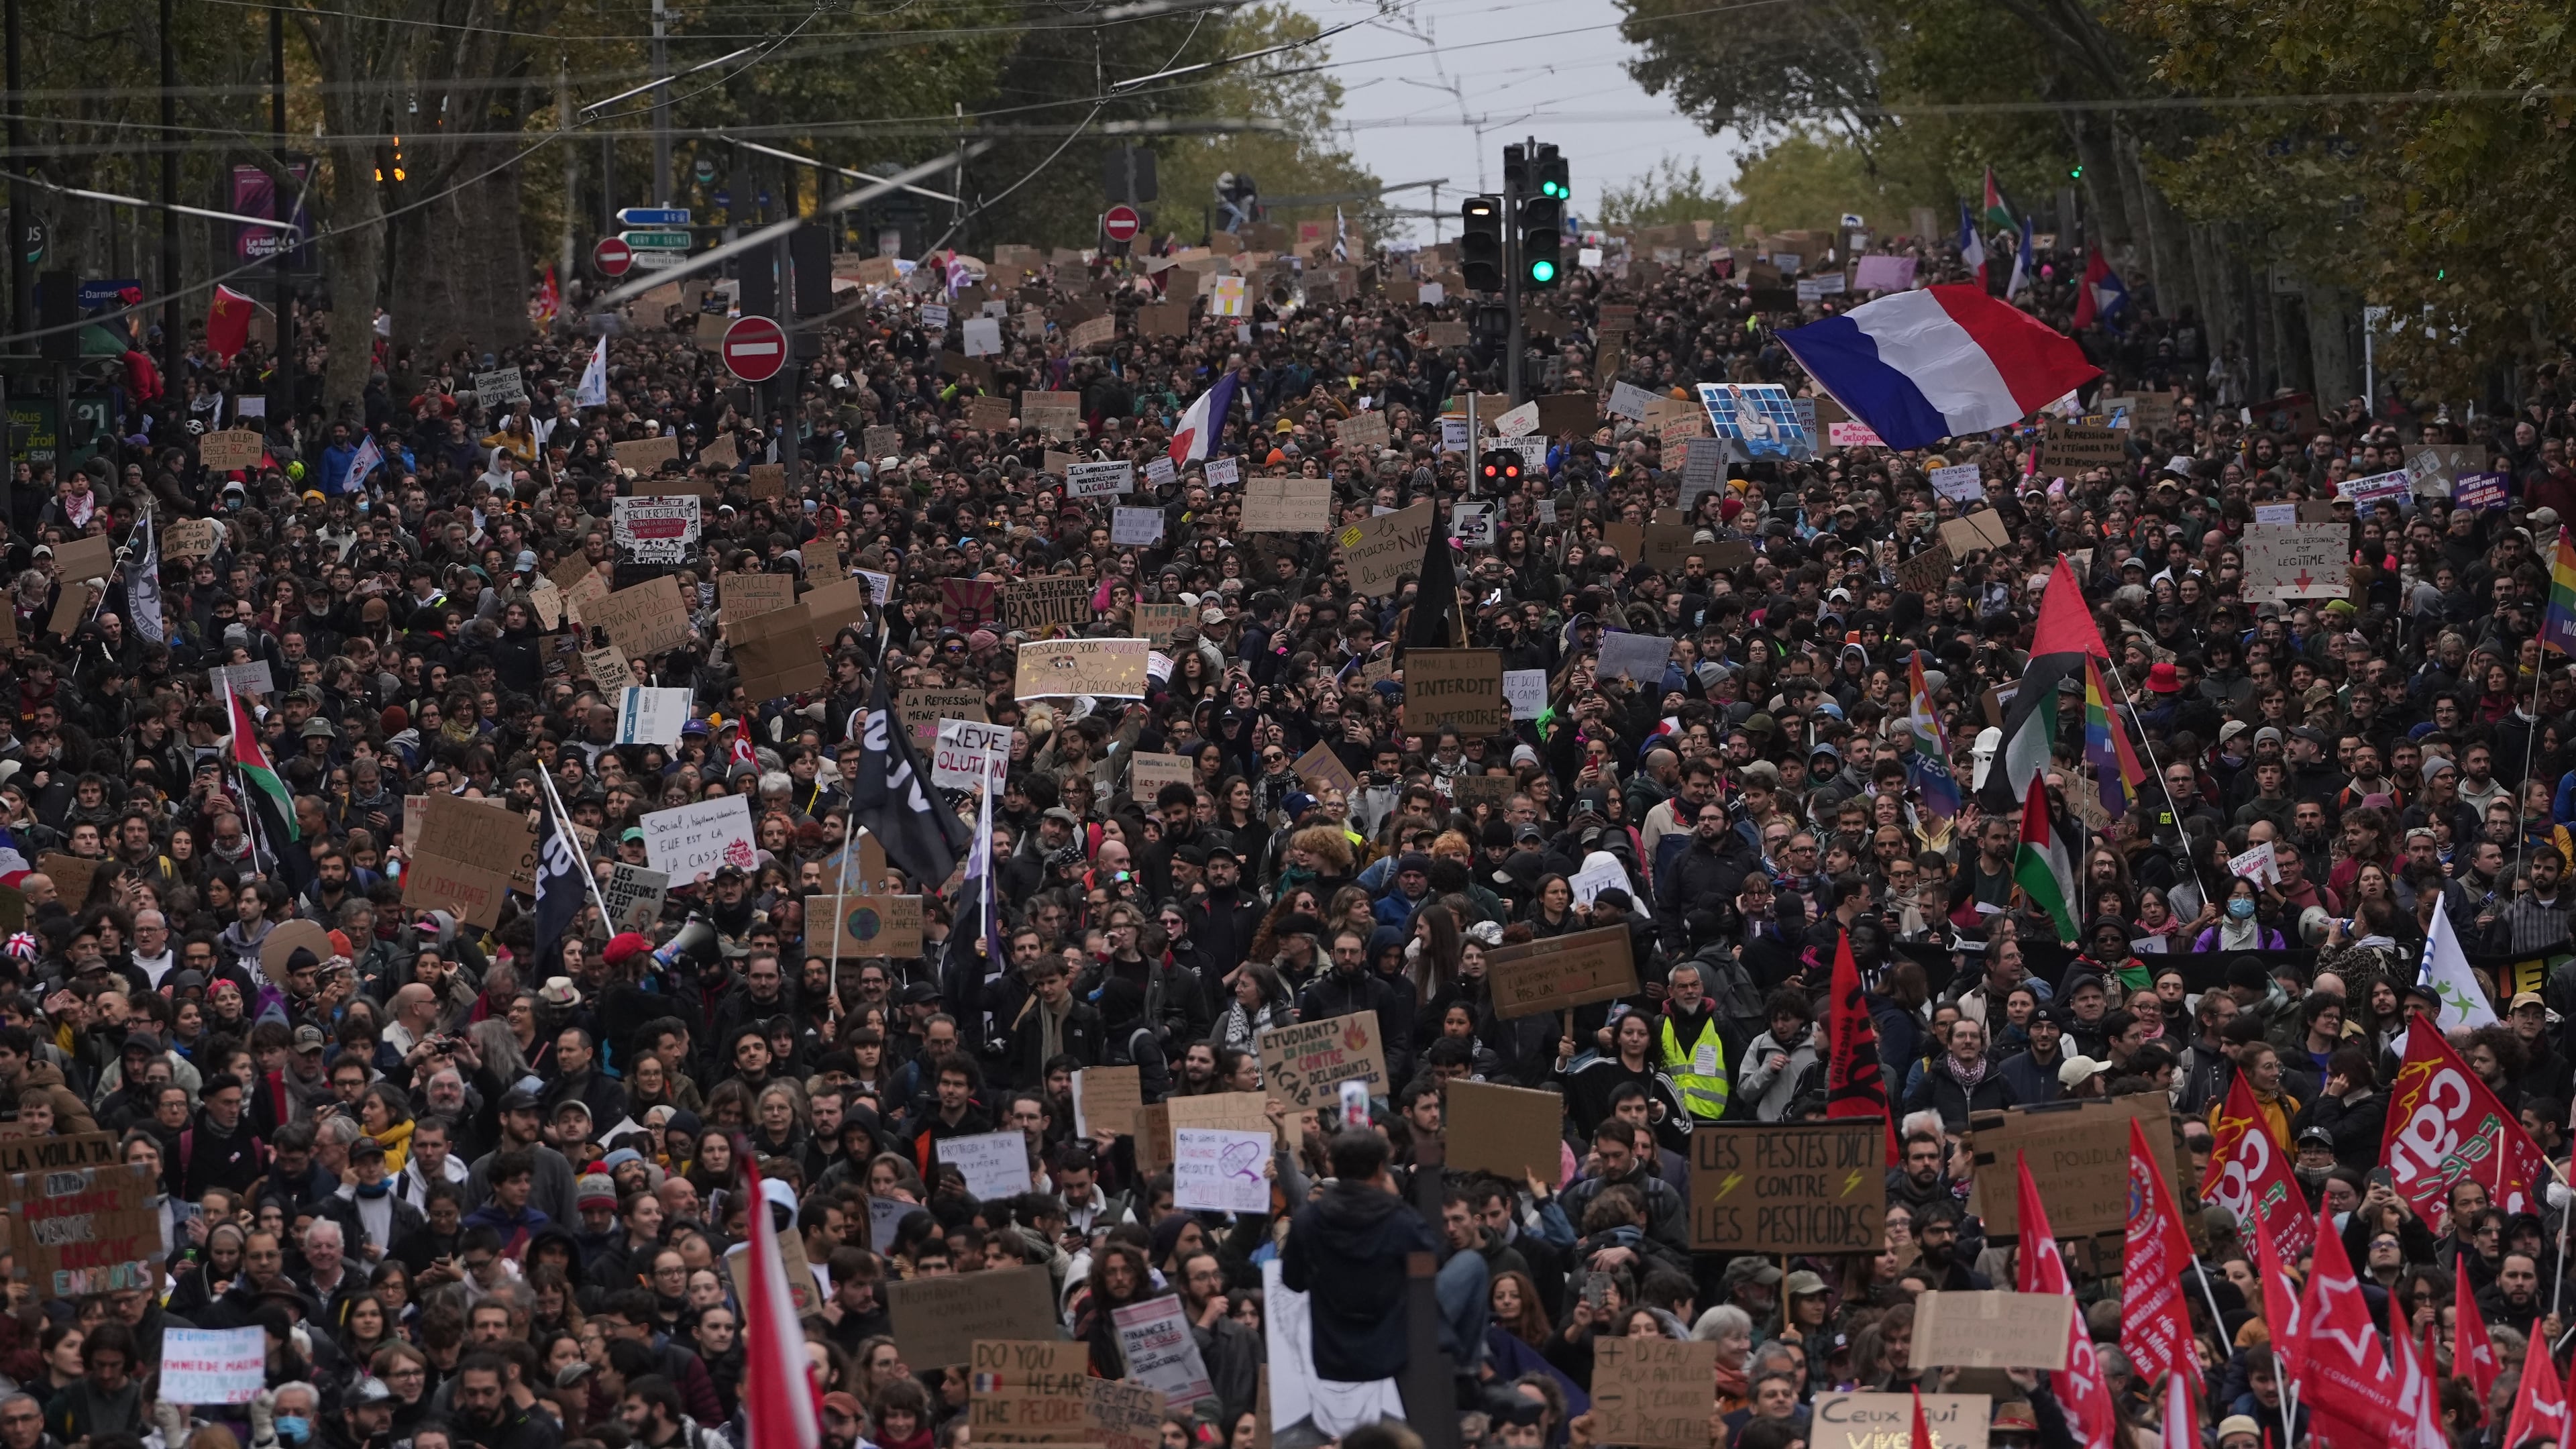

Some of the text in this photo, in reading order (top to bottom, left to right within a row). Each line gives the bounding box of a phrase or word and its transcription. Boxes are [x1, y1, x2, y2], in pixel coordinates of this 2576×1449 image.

[2048, 427, 2059, 441] LA
[2104, 443, 2121, 453] PAS
[2044, 457, 2061, 466] NOS
[1299, 482, 1327, 492] VAUT
[2459, 475, 2482, 486] BAISSE
[2469, 478, 2496, 490] DES PRIX
[1079, 482, 1120, 494] LA COLÈRE
[2459, 486, 2498, 501] HAUSSE DES
[2471, 492, 2502, 504] SALAIRES
[625, 507, 643, 519] MERCI
[1248, 509, 1326, 519] QUE DE PORTER
[1373, 518, 1402, 538] la
[724, 576, 784, 592] ARTICLE 7
[1006, 579, 1087, 592] T'AS EU PEUR
[1006, 592, 1039, 602] QU'ON
[1041, 590, 1077, 599] PRENNE
[727, 597, 786, 610] DROIT DE
[1007, 596, 1088, 629] BASTILLE?
[1141, 606, 1191, 619] TIRER
[614, 631, 628, 642] ON
[656, 614, 673, 628] EU
[1020, 642, 1099, 658] BOSSLADY SOUS
[1466, 659, 1483, 669] EST
[237, 674, 260, 684] FIRED
[1521, 676, 1542, 687] DOIT
[1414, 678, 1495, 698] INTERDIT
[906, 695, 918, 706] LA
[1517, 690, 1540, 700] CAMP
[908, 711, 934, 720] MENE
[407, 800, 418, 809] ON
[686, 835, 701, 846] EST
[665, 846, 730, 873] LA CASSE
[614, 867, 633, 881] LES
[609, 879, 657, 901] CASSEURS
[606, 891, 633, 908] C'EST
[892, 900, 918, 908] POUR
[892, 908, 918, 916] NOTRE
[807, 918, 835, 930] PAYS
[1538, 983, 1554, 996] UN
[1263, 1020, 1340, 1049] ETUDIANTS
[1298, 1048, 1344, 1072] CONTRE
[2, 1140, 113, 1171] LA VOILA TA
[1699, 1134, 1741, 1171] LES
[1755, 1130, 1831, 1169] PESTES
[1754, 1173, 1829, 1199] CONTRE
[1697, 1201, 1875, 1248] LES PESTICIDES
[52, 1259, 153, 1297] ENFANTS
[977, 1342, 1055, 1371] DO YOU
[1635, 1339, 1691, 1366] D'EAU
[1026, 1372, 1084, 1399] HEAR
[970, 1398, 1083, 1425] THE PEOPLE
[1820, 1397, 1901, 1424] Ceux
